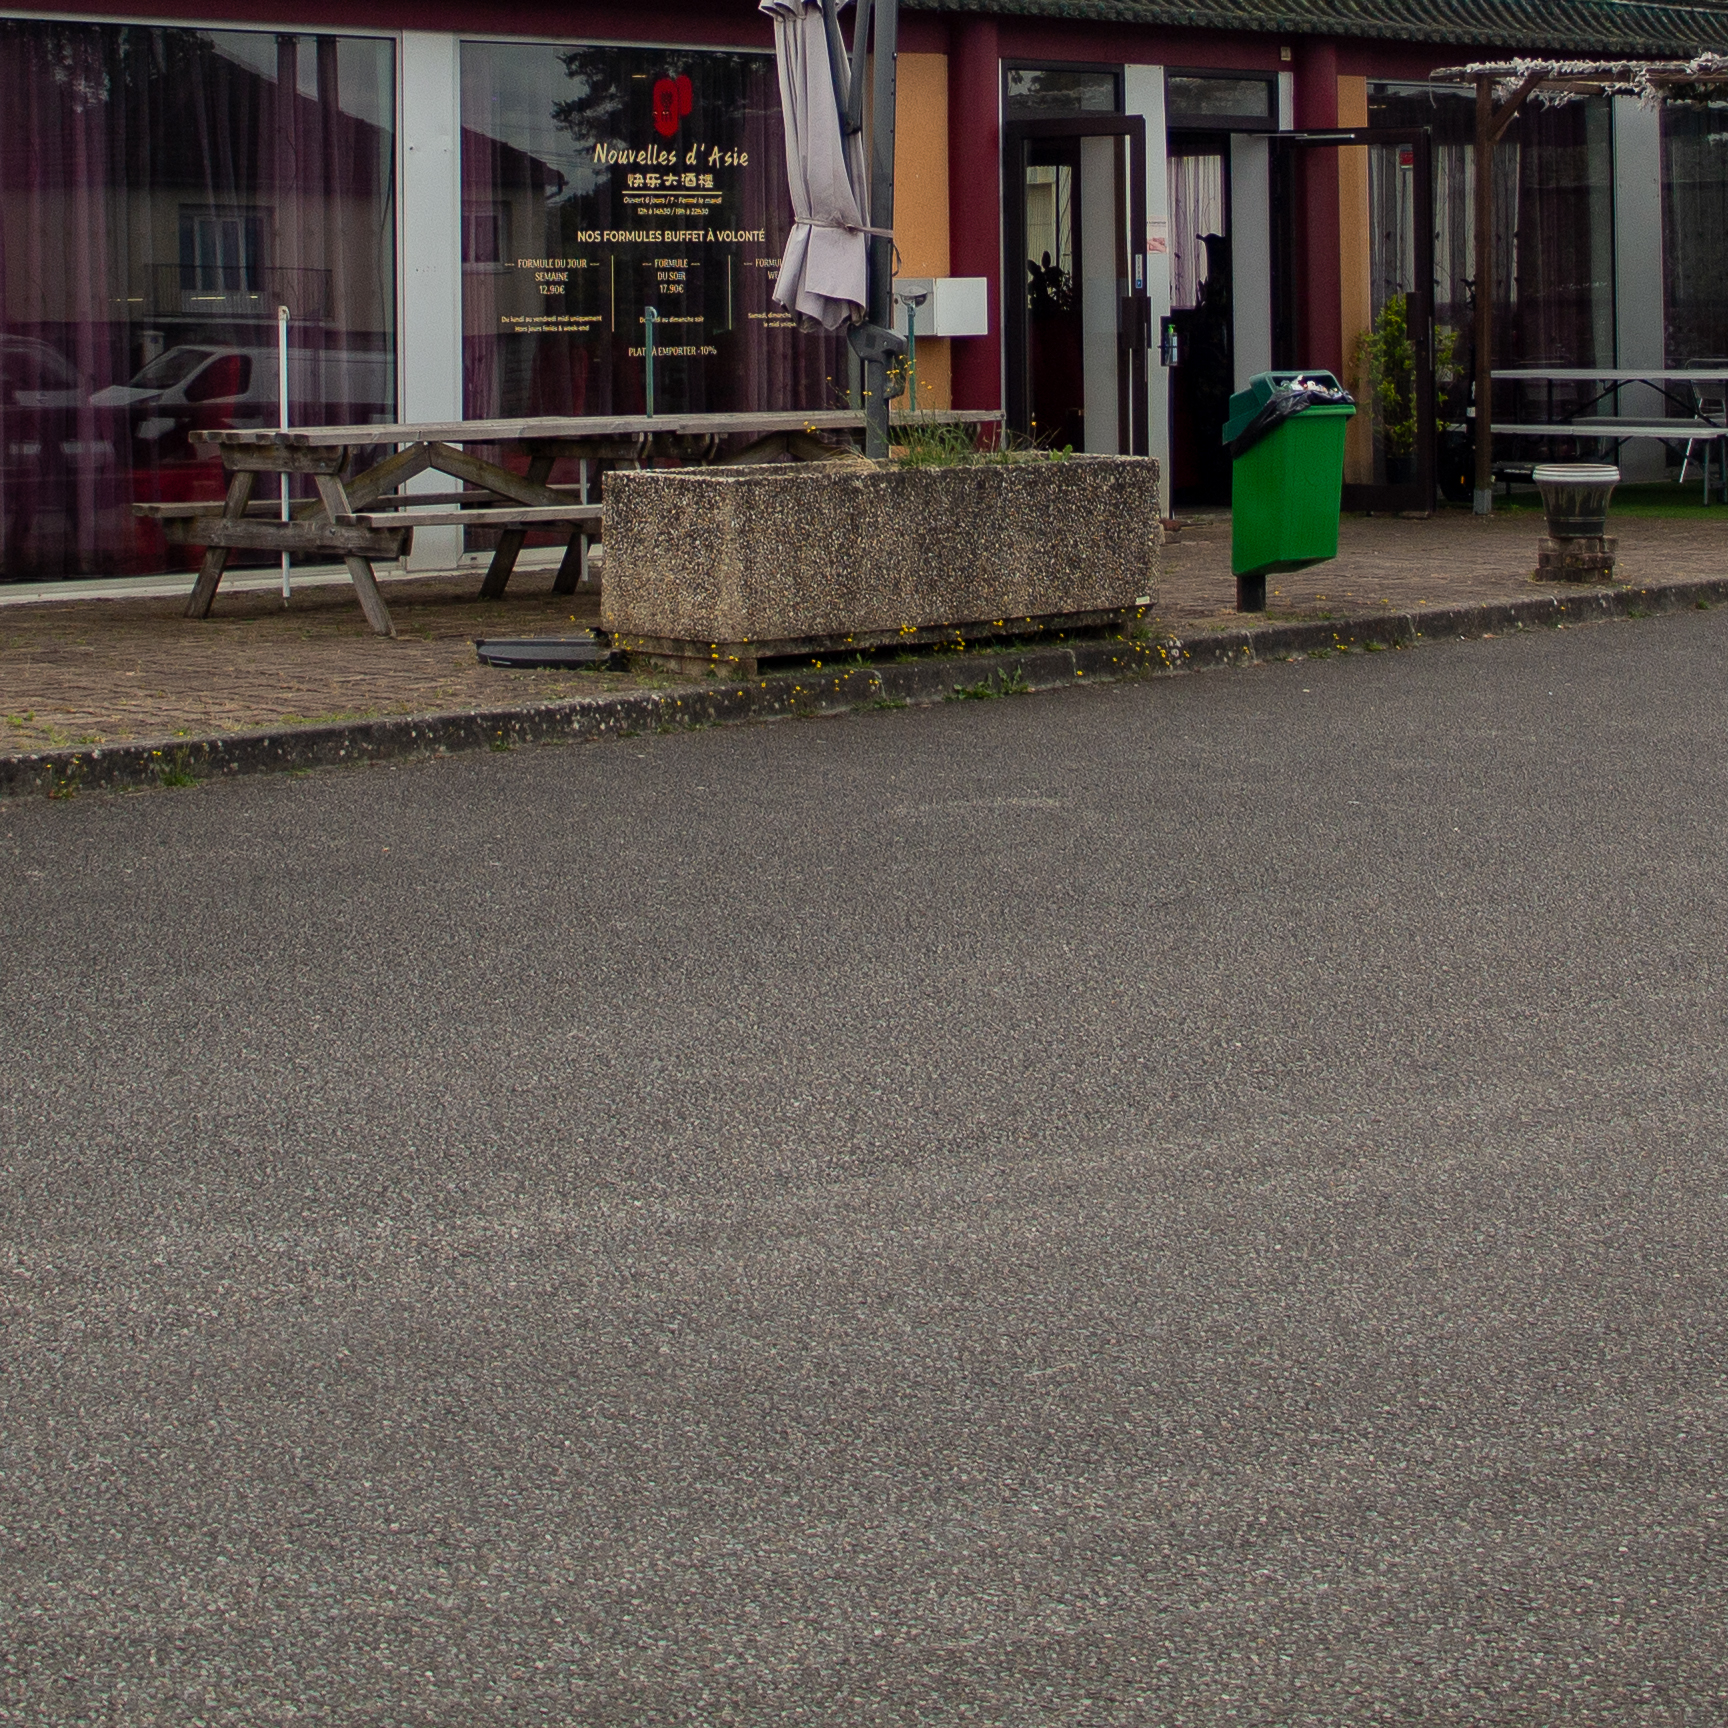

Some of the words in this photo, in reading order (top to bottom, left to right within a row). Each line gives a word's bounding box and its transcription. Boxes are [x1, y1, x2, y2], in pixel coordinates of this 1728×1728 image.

[593, 142, 677, 166] Nouvelles
[577, 230, 600, 242] NOS
[603, 230, 662, 242] FORMULES
[664, 230, 705, 242] BUFFET
[706, 227, 715, 242] À
[716, 228, 765, 242] VOLONTÉ
[517, 258, 553, 268] FORMULE
[554, 258, 566, 268] DU
[567, 258, 587, 268] JOUR
[654, 258, 689, 268] FORMULE
[534, 272, 568, 282] SEMAINE
[657, 271, 667, 280] DU
[658, 346, 696, 356] EMPORTER
